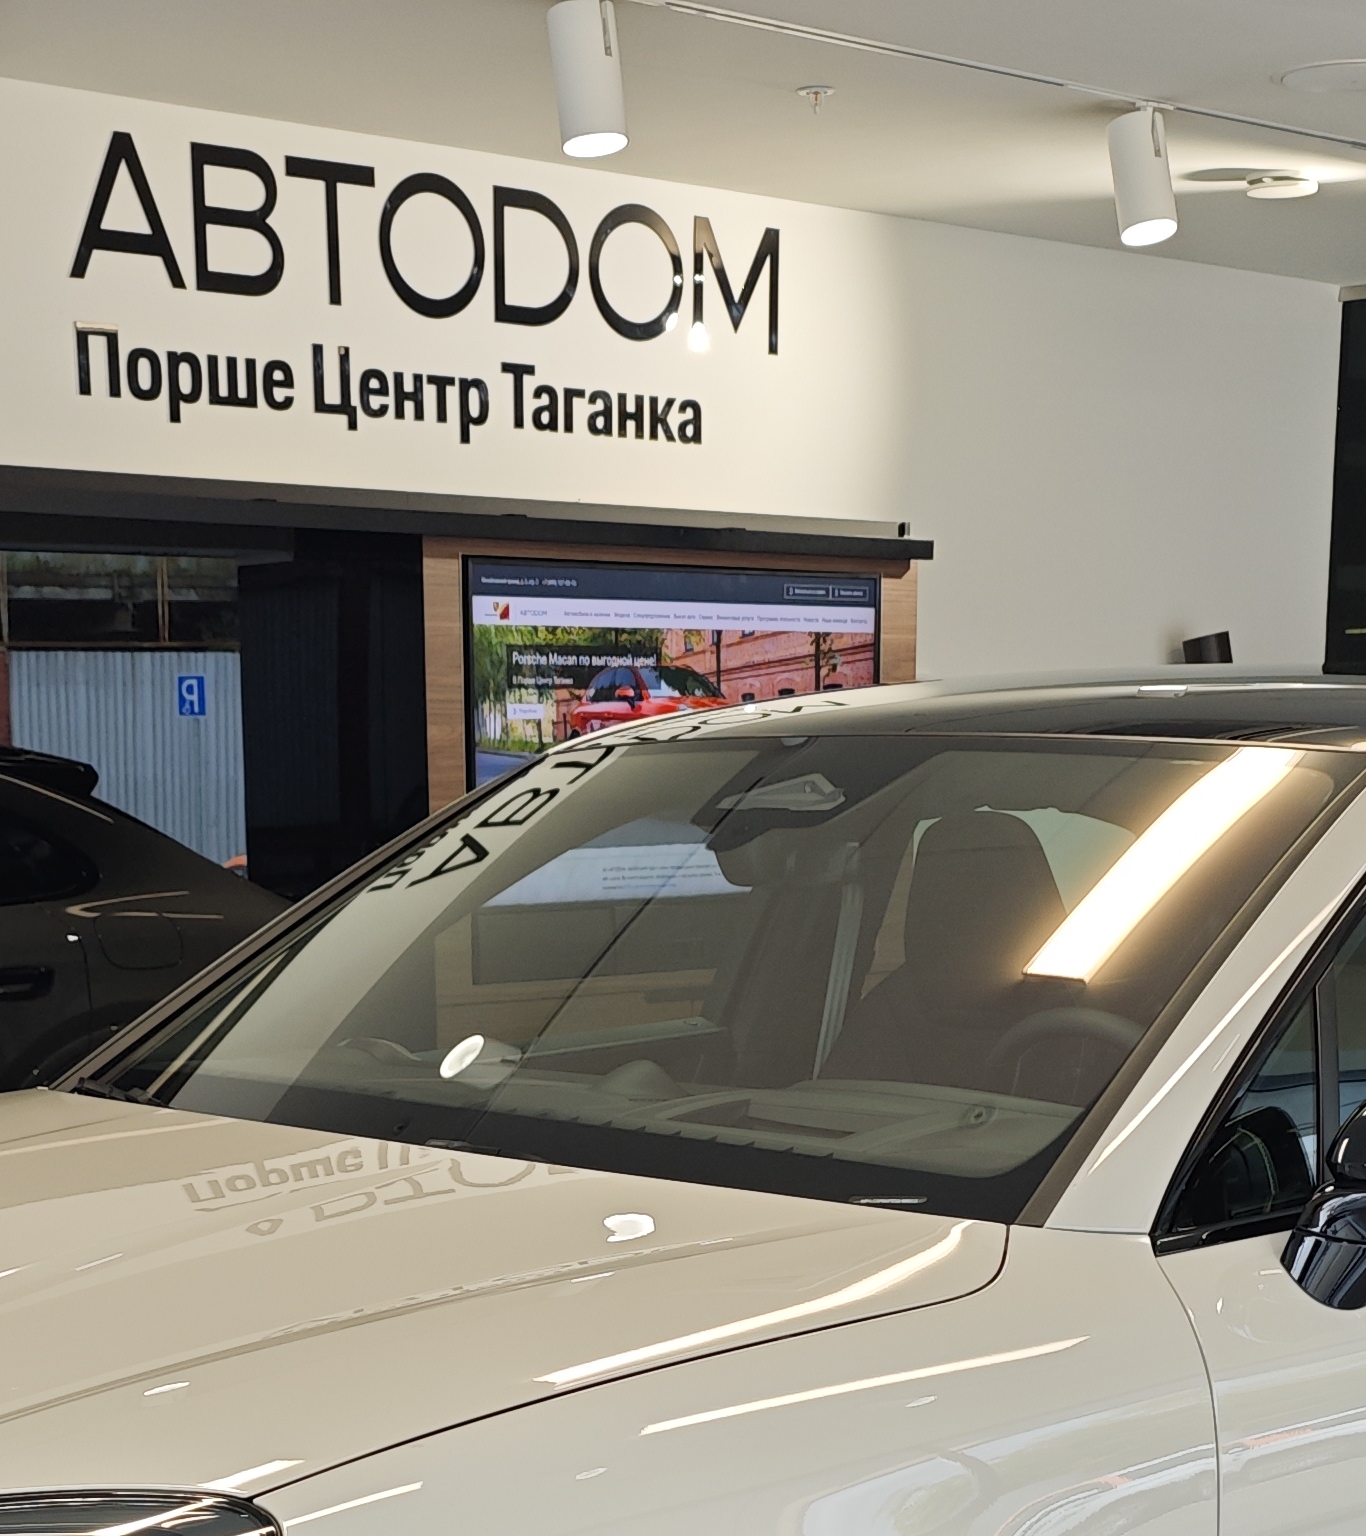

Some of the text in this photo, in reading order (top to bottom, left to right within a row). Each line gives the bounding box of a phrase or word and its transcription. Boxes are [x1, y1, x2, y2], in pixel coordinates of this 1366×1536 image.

[73, 320, 703, 445] Порше Центр Таганка
[512, 651, 547, 667] Porsche
[548, 652, 578, 667] Macan
